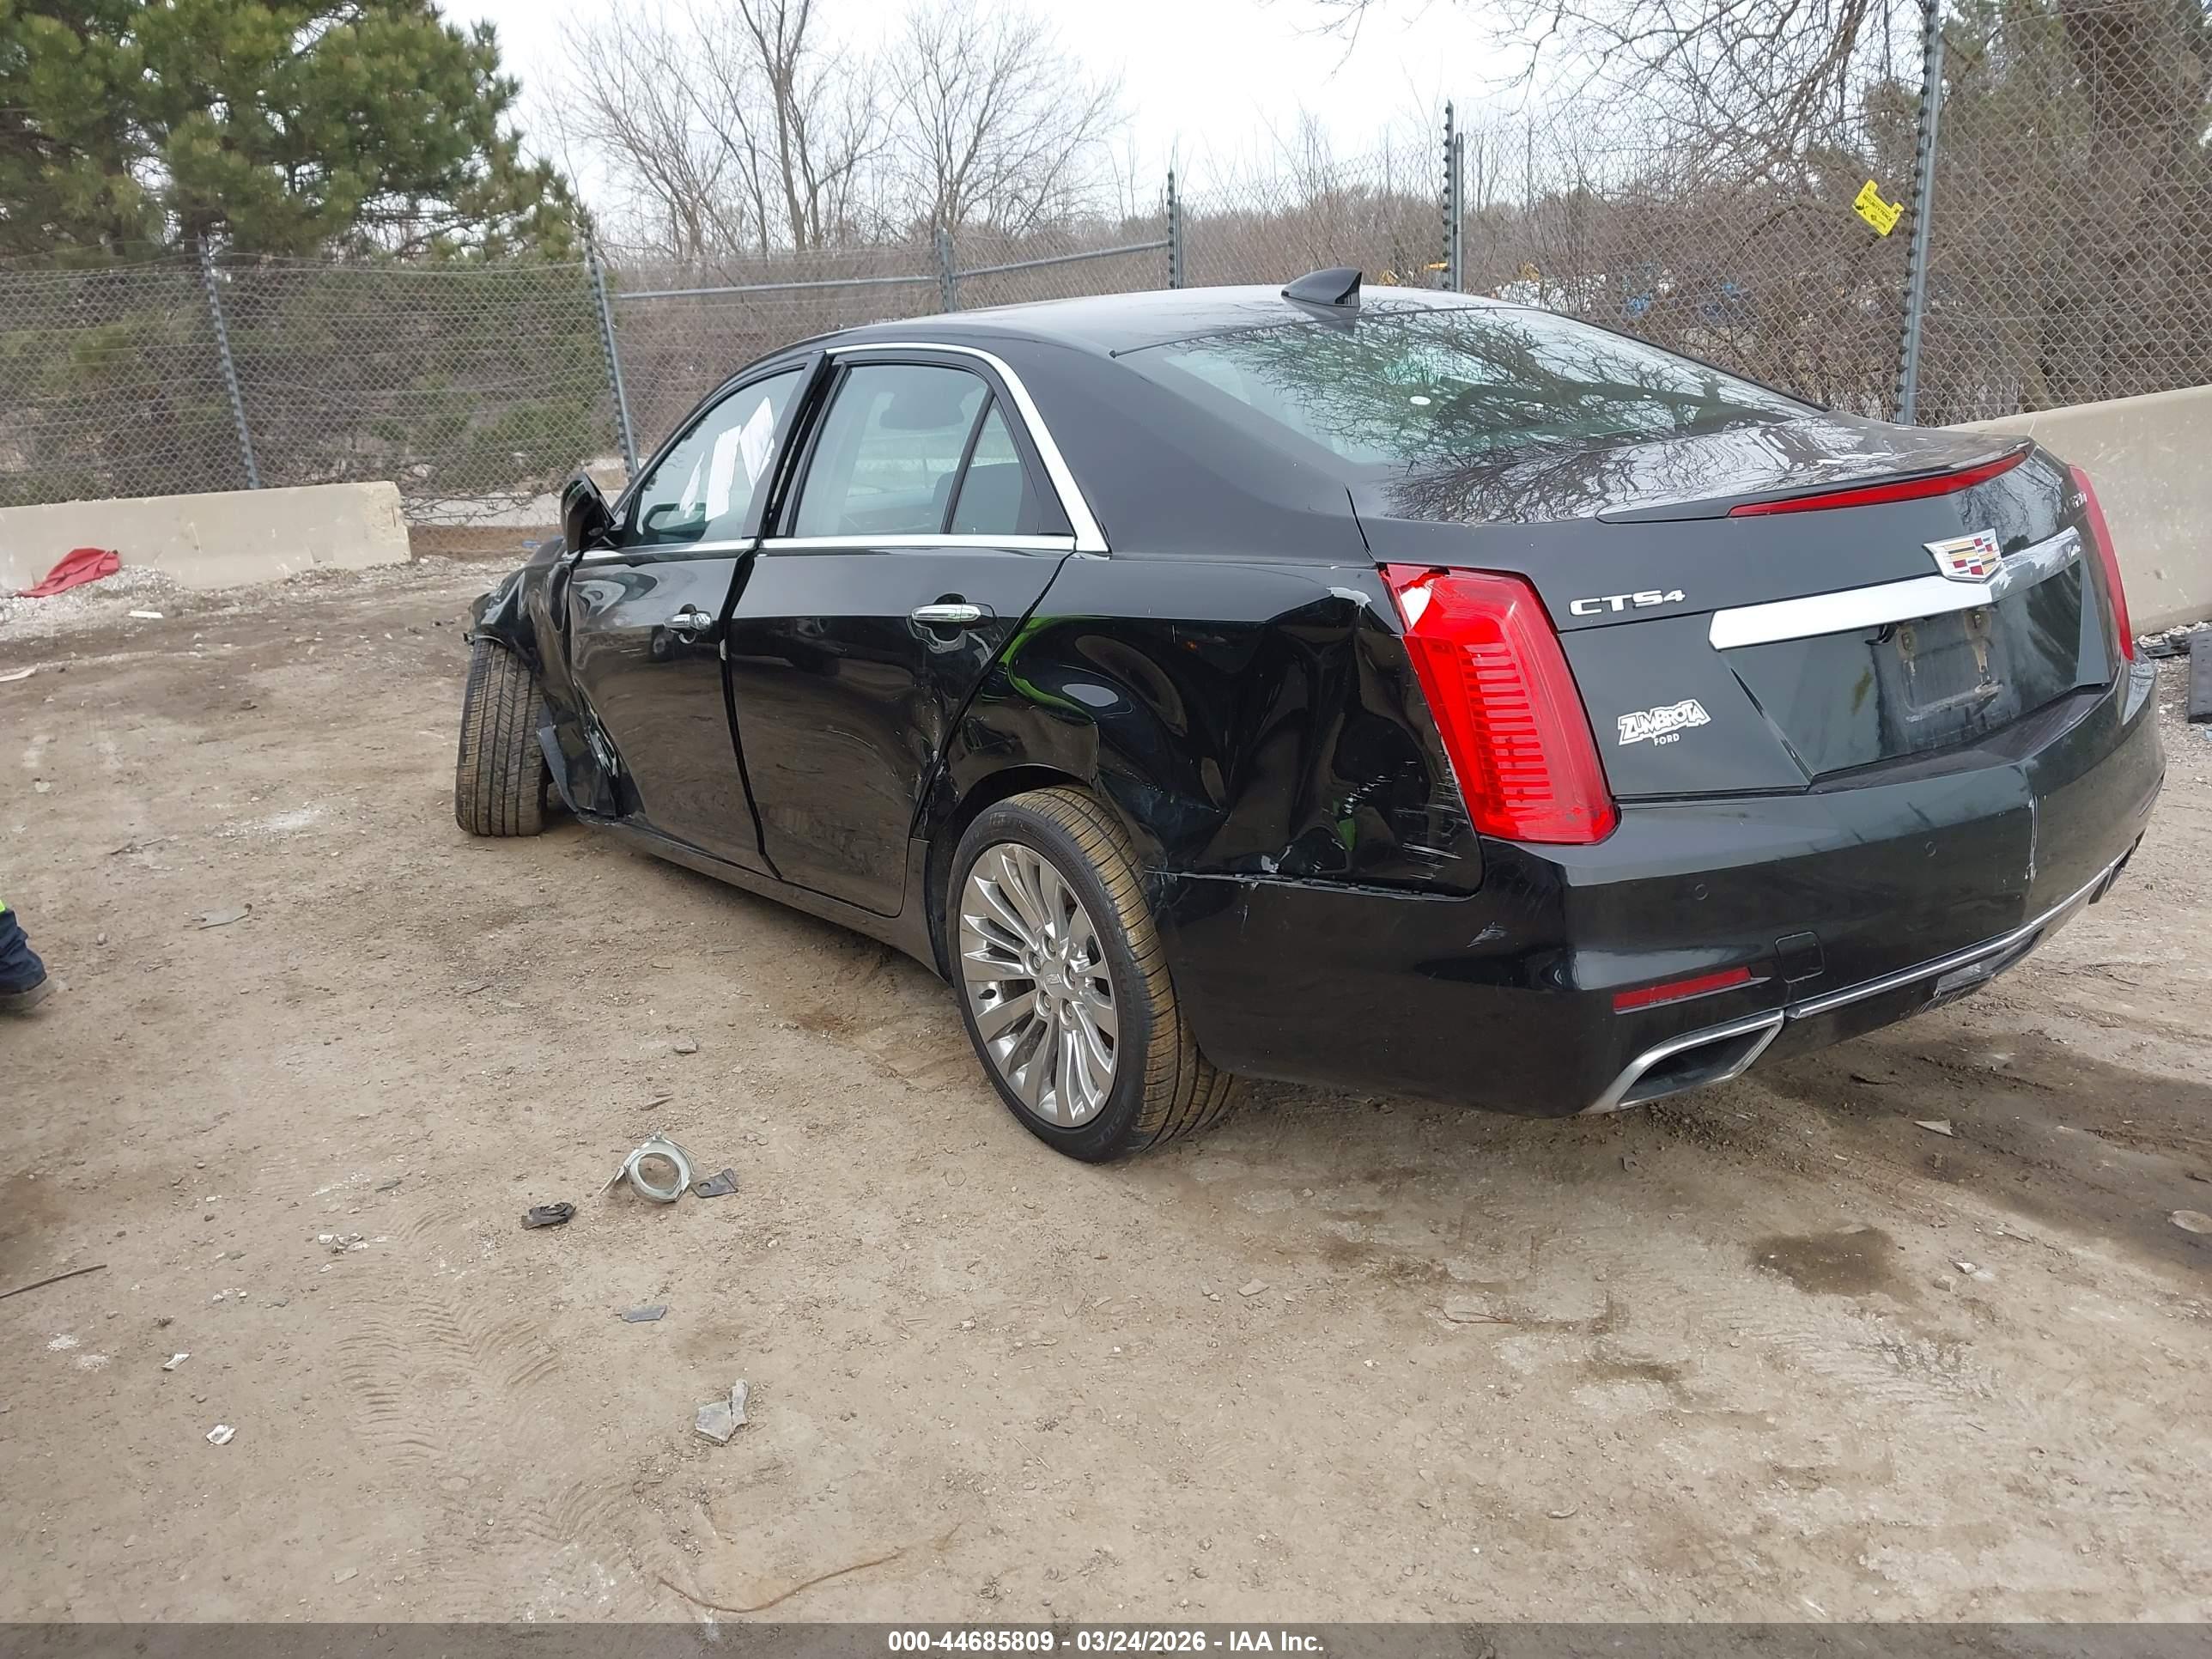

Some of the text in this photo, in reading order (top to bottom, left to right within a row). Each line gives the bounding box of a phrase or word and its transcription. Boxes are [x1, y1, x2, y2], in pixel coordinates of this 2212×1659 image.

[1569, 589, 1686, 616] CTS4
[1620, 701, 1708, 743] ZUMBROTA
[1654, 733, 1680, 746] FORD
